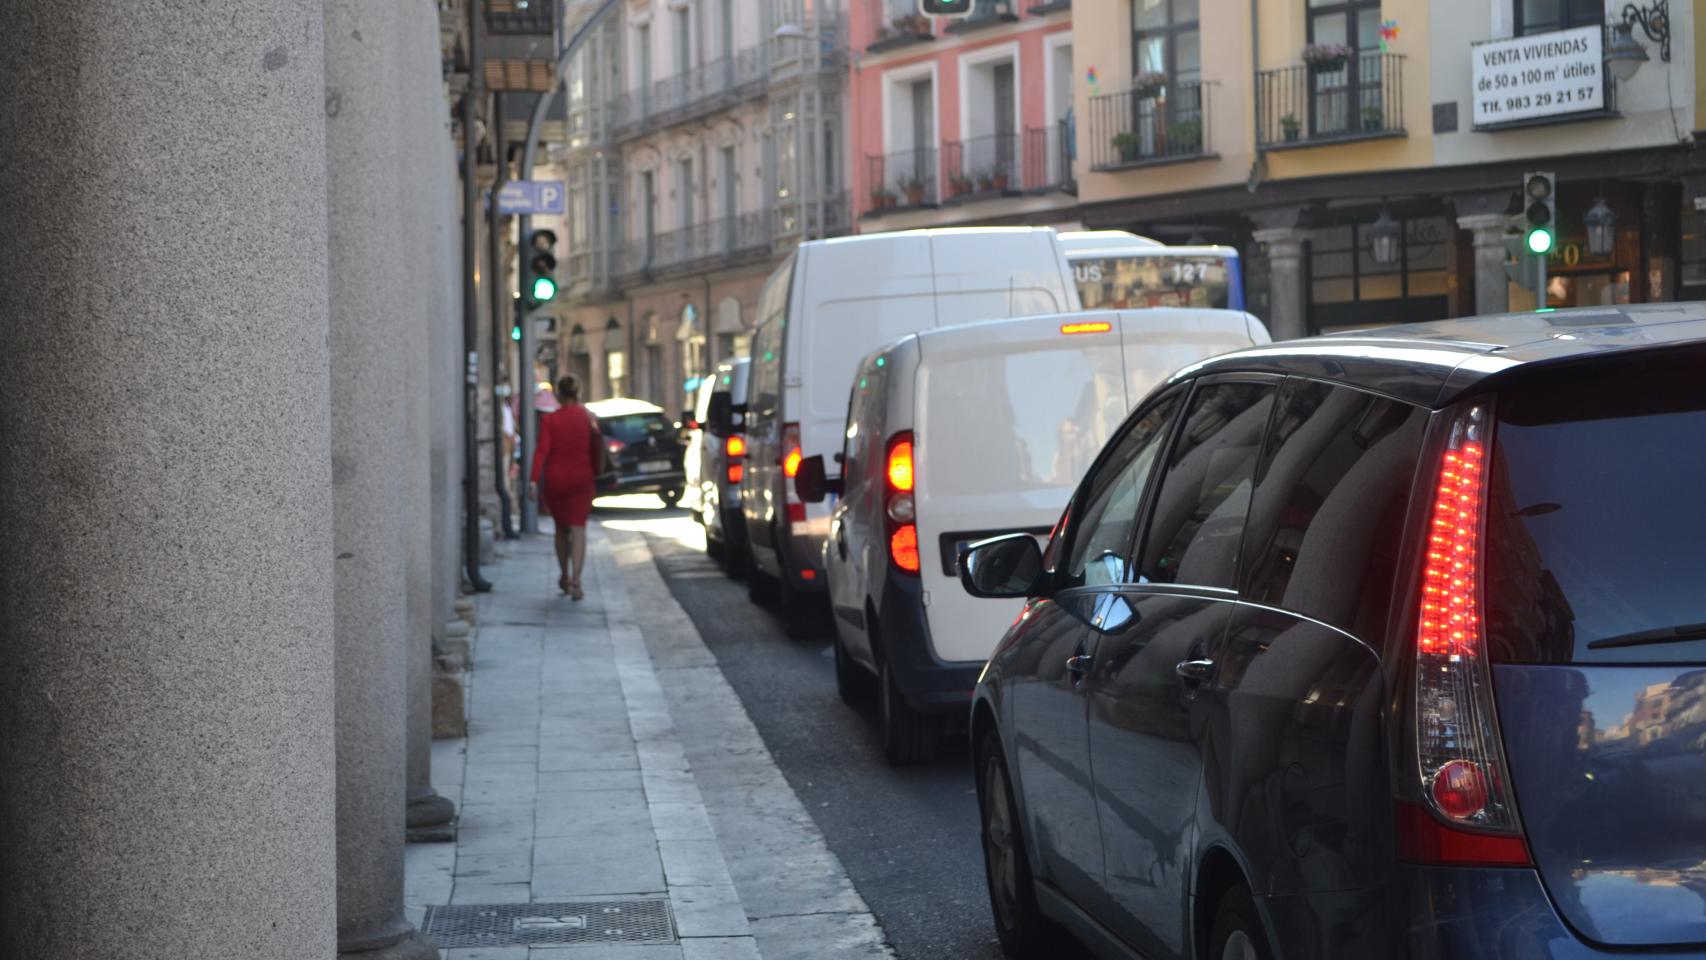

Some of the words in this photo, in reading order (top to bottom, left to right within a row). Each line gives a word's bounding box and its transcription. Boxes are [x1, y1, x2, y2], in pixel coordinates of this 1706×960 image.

[1483, 49, 1521, 67] VENTA
[1524, 37, 1588, 60] VIVIENDAS
[1478, 76, 1492, 91] de
[1495, 74, 1508, 88] 50
[1511, 77, 1517, 86] a
[1521, 69, 1541, 85] 100
[1563, 62, 1596, 79] útiles
[1506, 95, 1531, 111] 983
[1536, 92, 1552, 107] 29
[1556, 89, 1571, 104] 21
[1577, 86, 1594, 100] 57
[543, 187, 557, 208] P
[1173, 263, 1208, 281] 127
